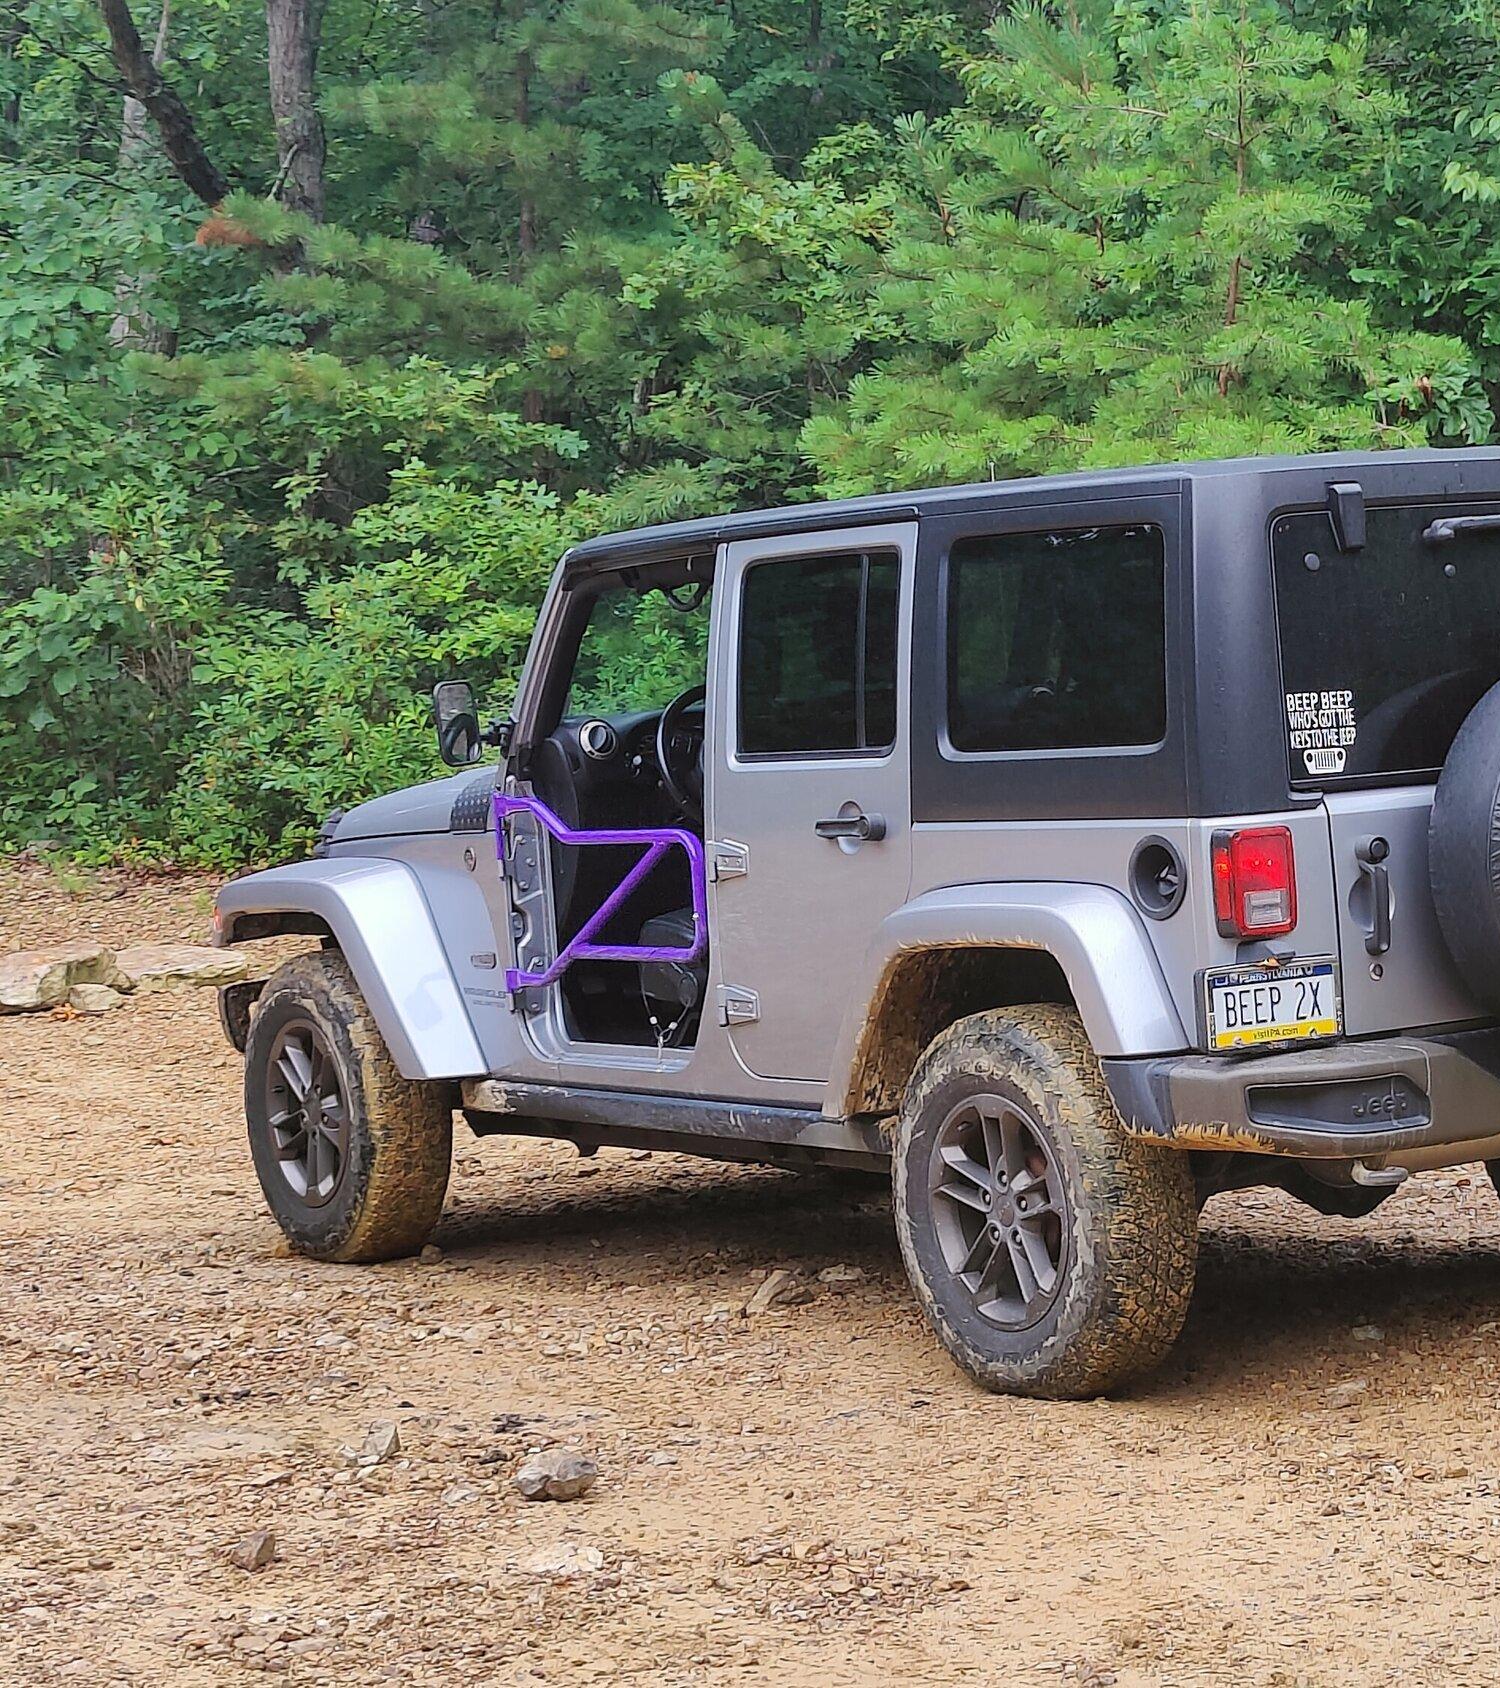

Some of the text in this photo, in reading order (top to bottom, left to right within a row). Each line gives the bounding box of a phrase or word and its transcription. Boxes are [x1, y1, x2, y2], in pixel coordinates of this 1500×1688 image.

[1286, 690, 1353, 711] BEEP BEEP
[1288, 707, 1356, 729] WHO'S GOT THE
[1289, 729, 1311, 749] KEYS
[1311, 728, 1322, 748] TO
[1322, 728, 1339, 747] THE
[1224, 986, 1281, 1028] BEEP
[1294, 981, 1322, 1021] 2X
